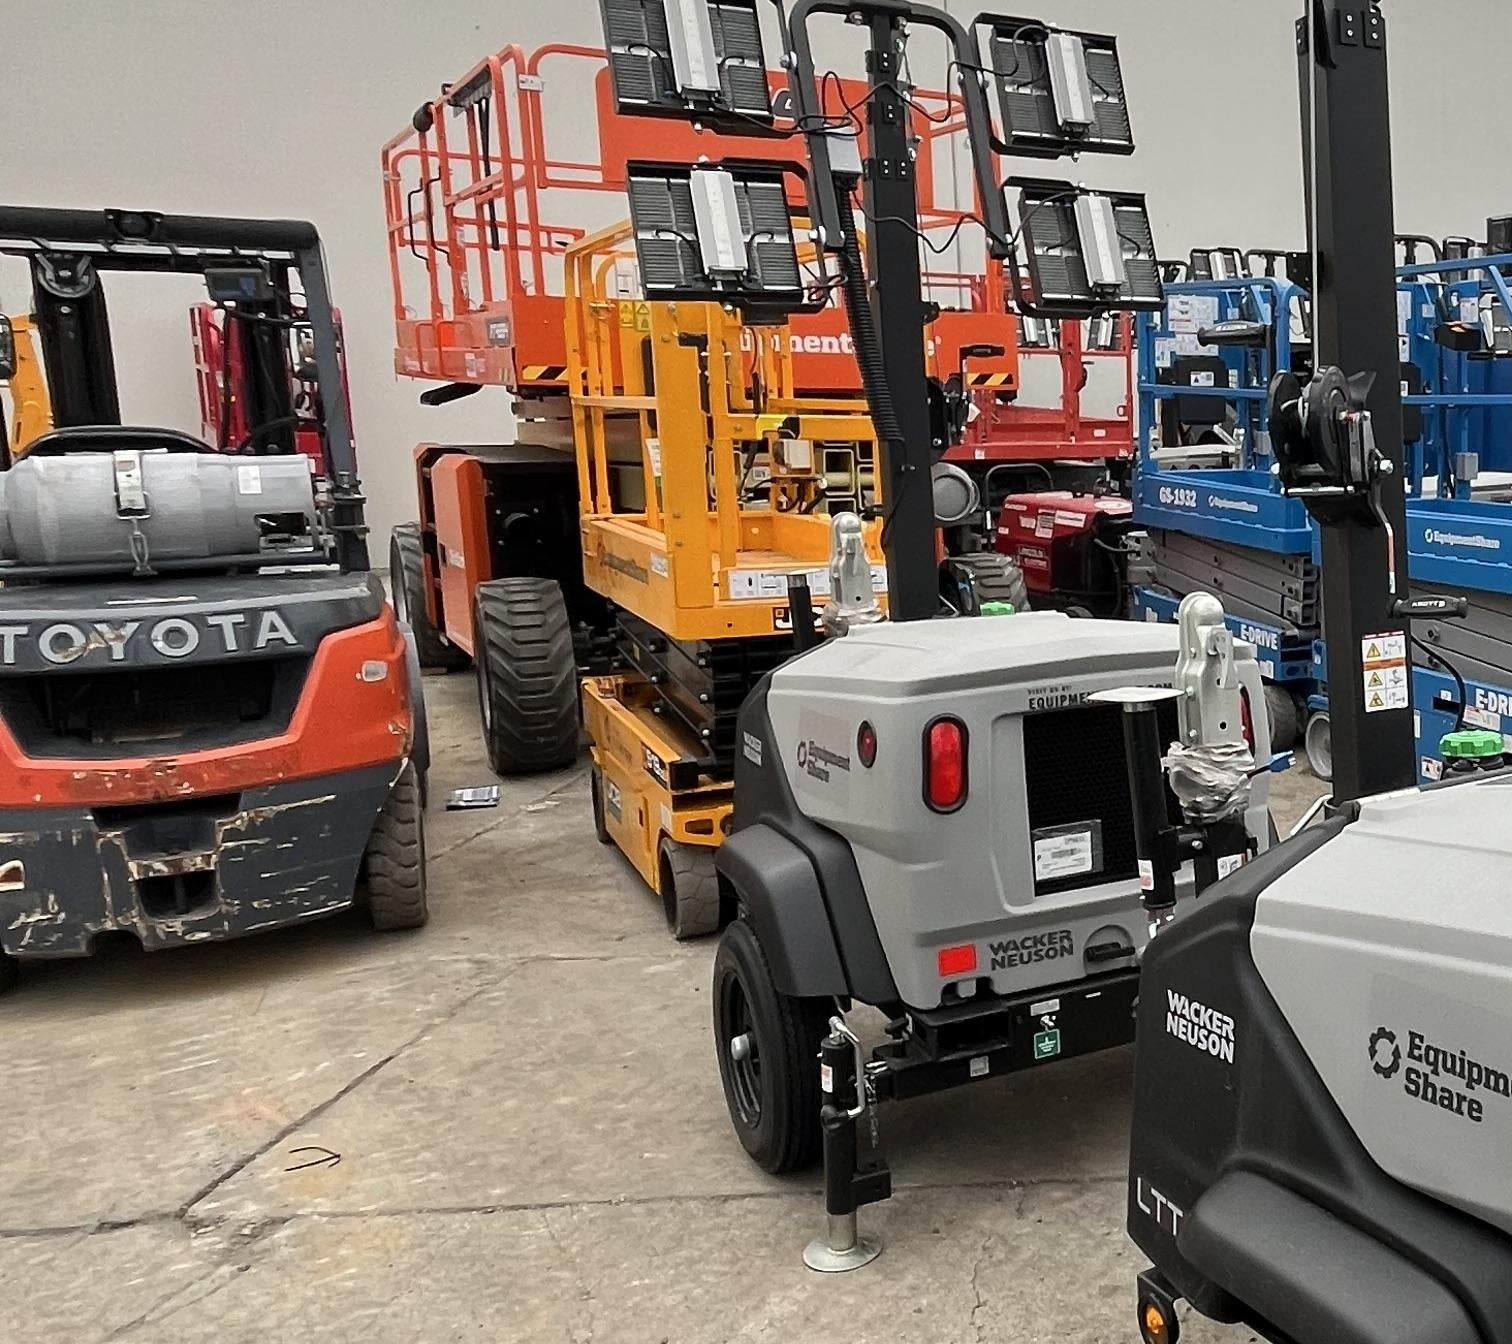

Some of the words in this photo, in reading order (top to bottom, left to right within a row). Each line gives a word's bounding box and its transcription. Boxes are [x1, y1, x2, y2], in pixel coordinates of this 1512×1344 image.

[0, 610, 298, 665] TOYOTA
[1241, 623, 1278, 650] E-DRIVE
[989, 929, 1073, 956] WACKER
[991, 943, 1074, 971] NEUSON
[1166, 1011, 1235, 1064] NEUSON
[1167, 989, 1235, 1042] WACKER
[1404, 1067, 1483, 1122] Share
[1137, 1177, 1184, 1236] LTT
